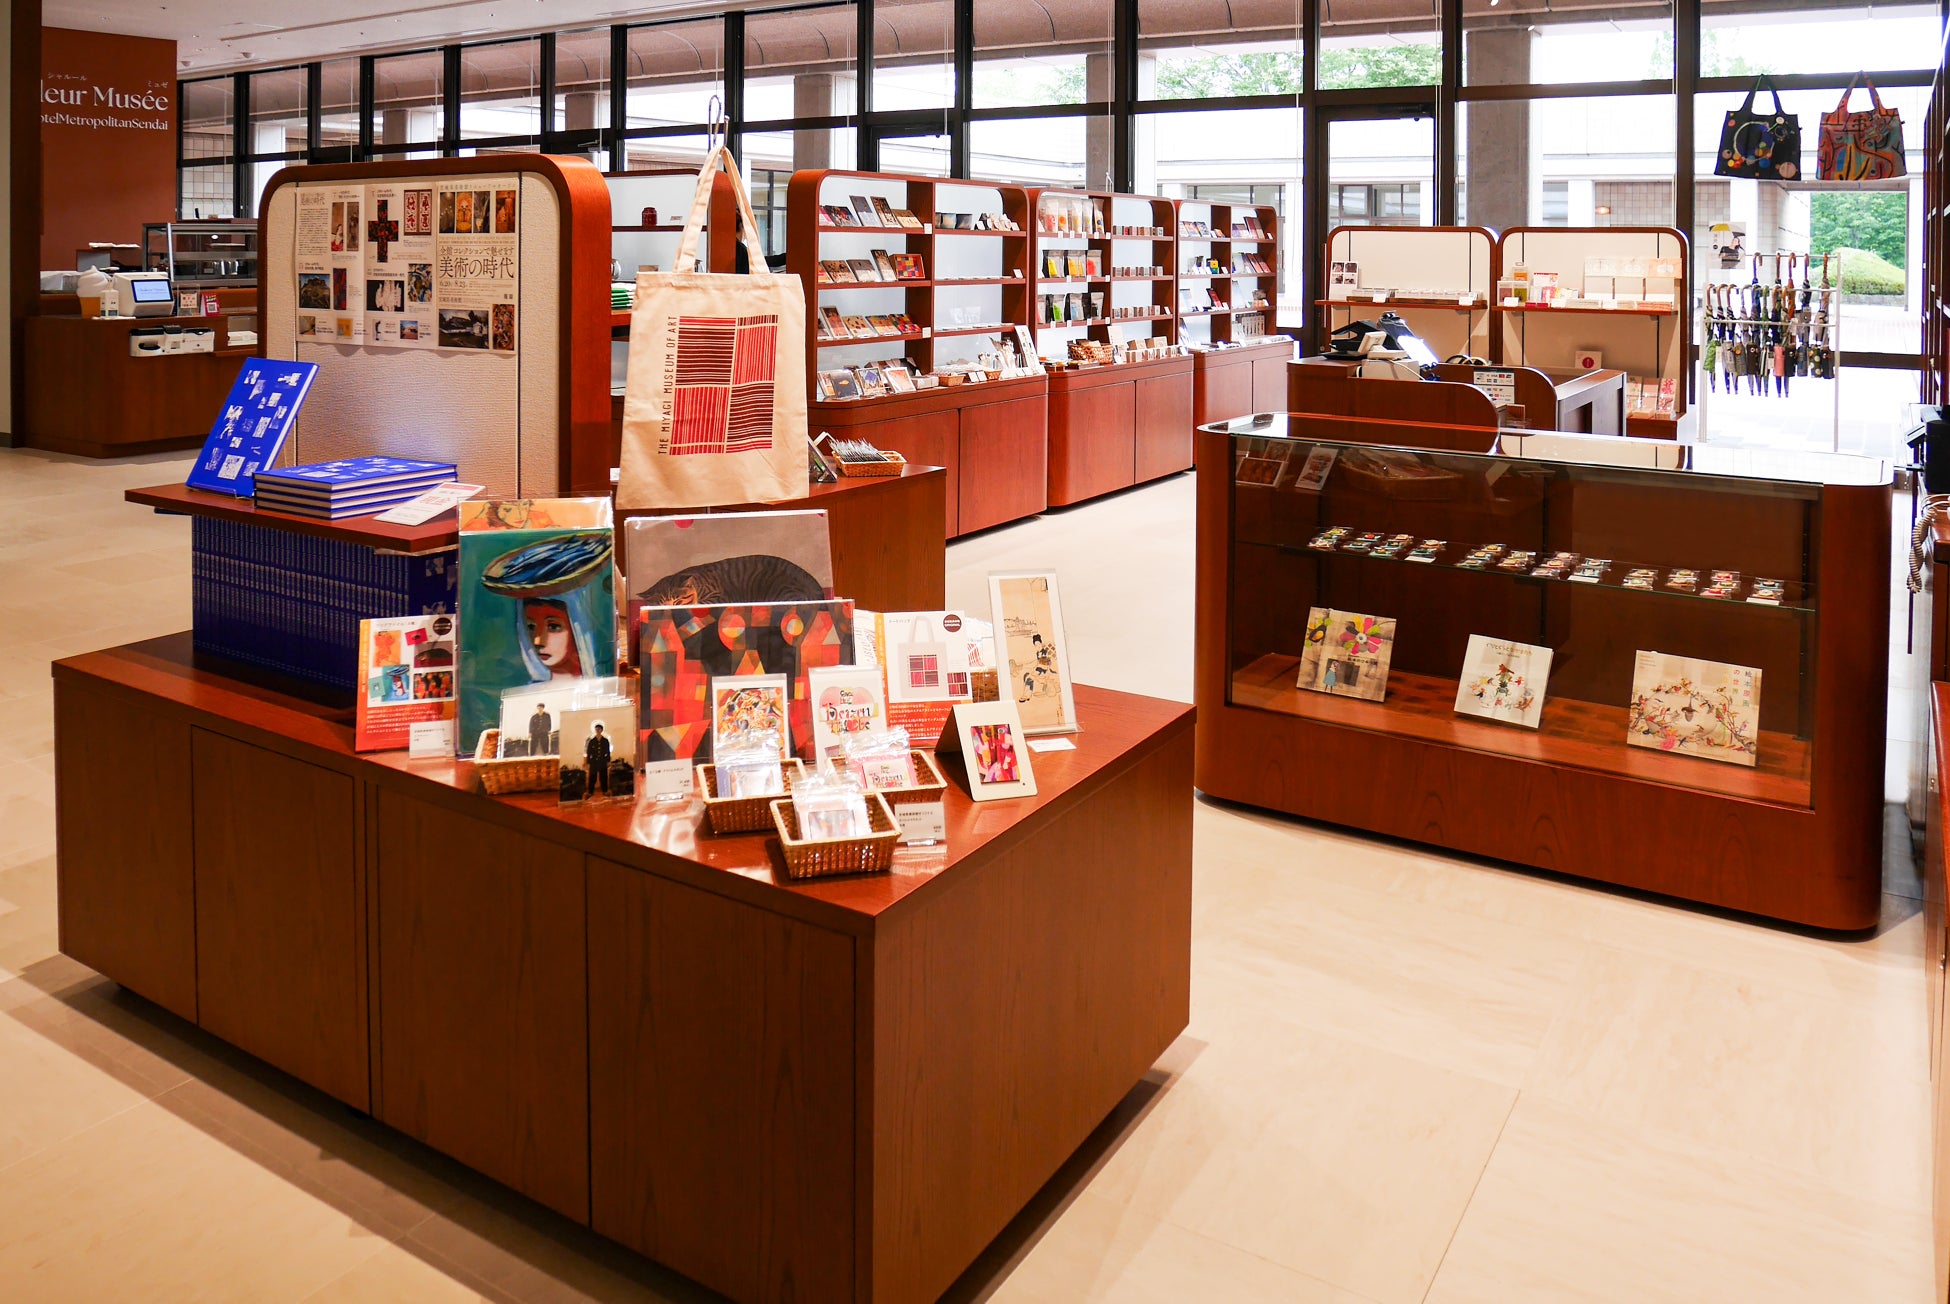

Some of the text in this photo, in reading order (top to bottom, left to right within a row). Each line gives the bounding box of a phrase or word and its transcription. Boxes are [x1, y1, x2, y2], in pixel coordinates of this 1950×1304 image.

[92, 86, 169, 111] Musée
[439, 256, 514, 279] 美術の時代
[658, 316, 677, 455] THE MIYAGI MUSEUM OF ART
